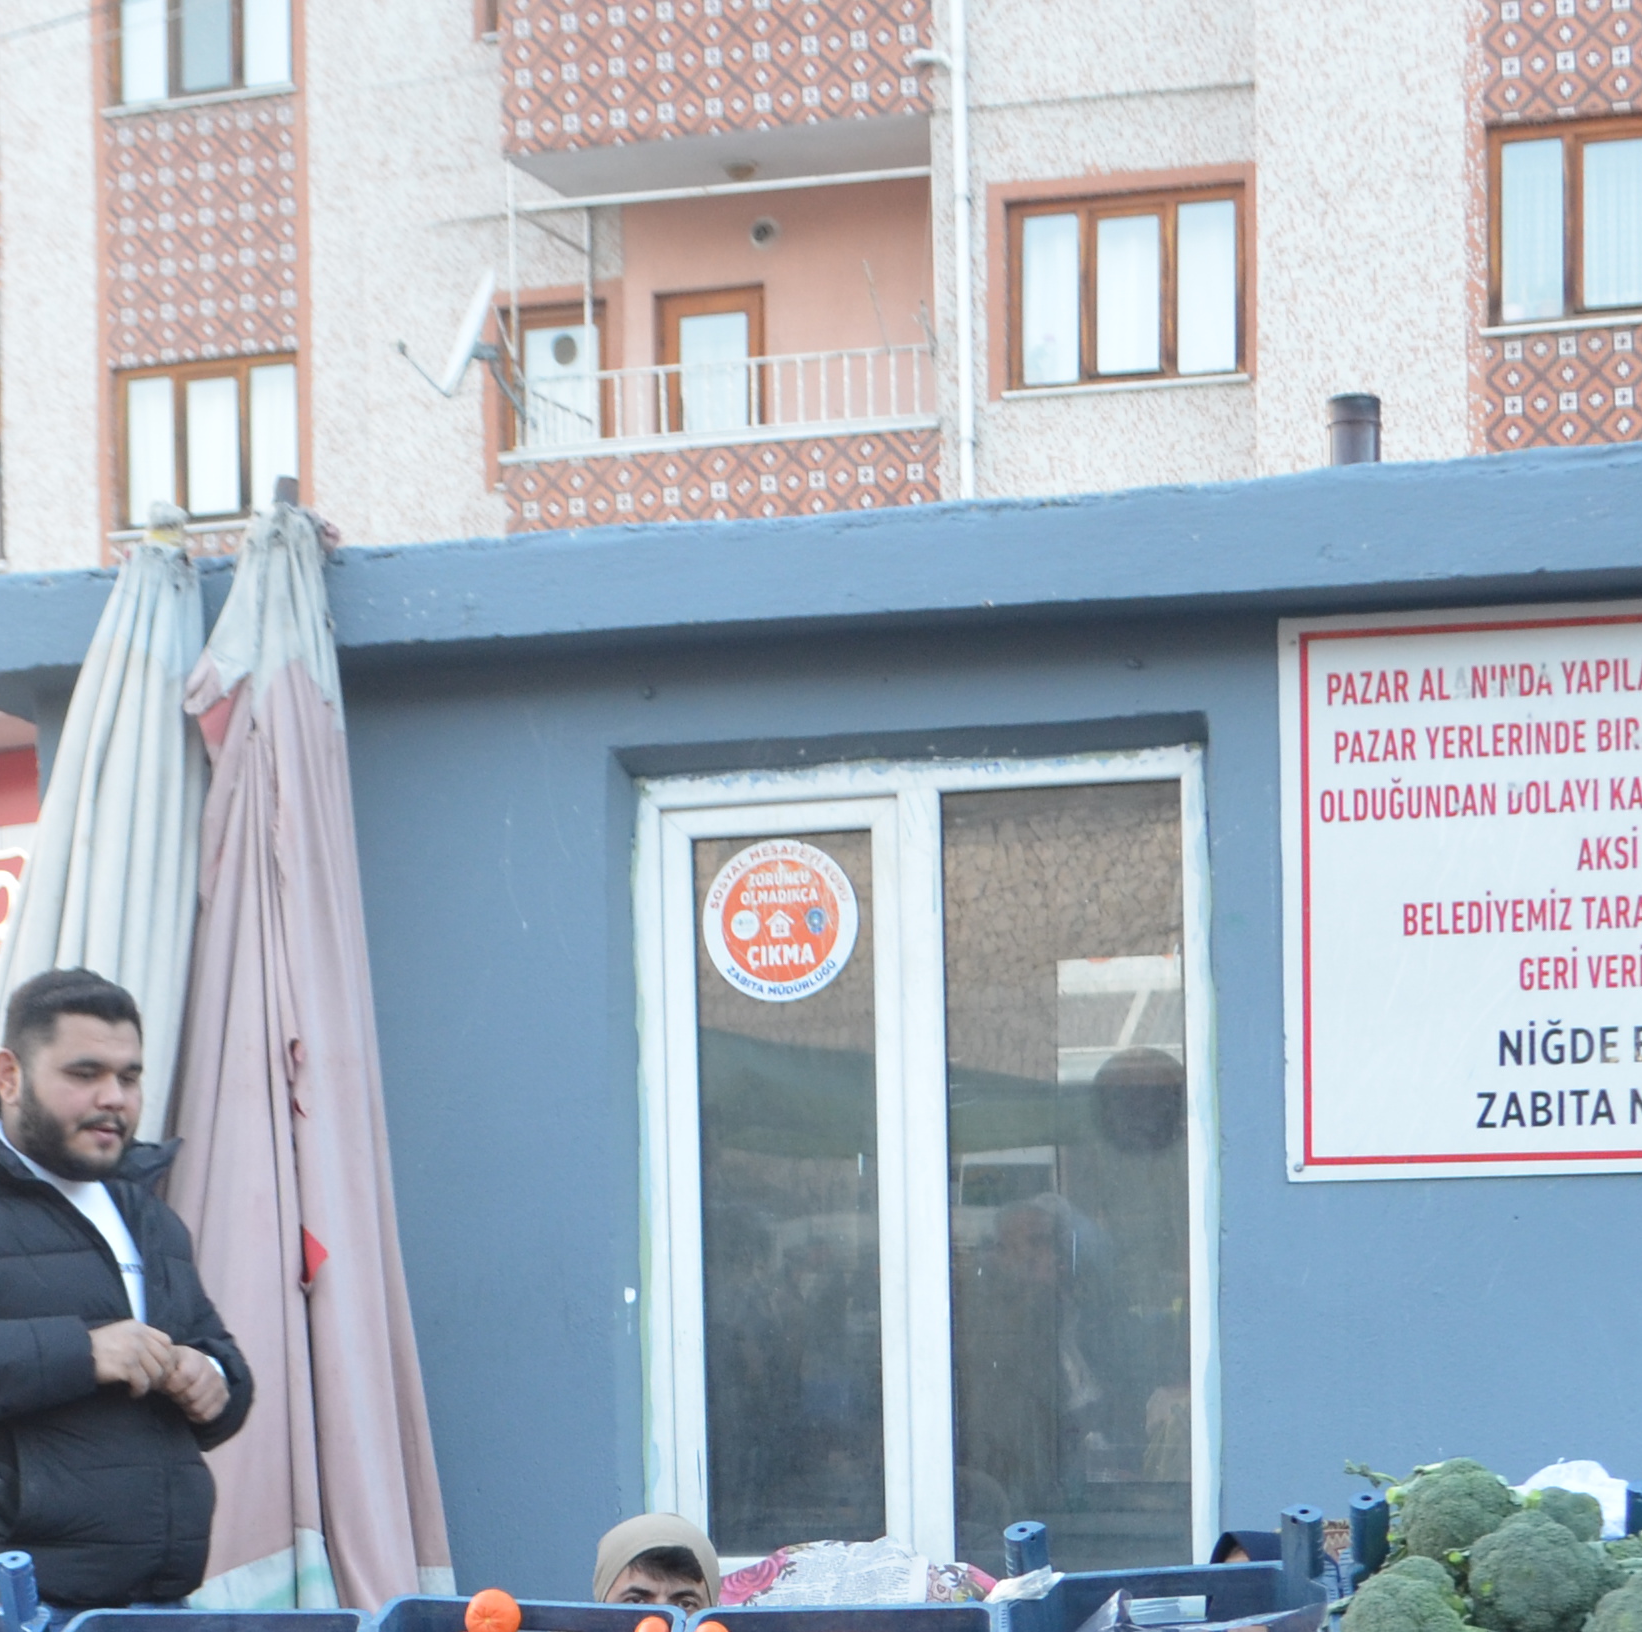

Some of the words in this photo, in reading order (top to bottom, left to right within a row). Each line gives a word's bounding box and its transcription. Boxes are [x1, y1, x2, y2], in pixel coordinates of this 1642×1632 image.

[1326, 669, 1410, 706] PAZAR
[1333, 727, 1417, 764] PAZAR
[1425, 715, 1587, 760] YERLERİNDE
[1319, 777, 1496, 823] OLDUĞUNDAN
[1507, 778, 1599, 816] DOLAYI
[1576, 825, 1638, 871] AKSİ
[710, 861, 749, 910] SOSYAL
[748, 844, 822, 867] MESAFEYİ
[740, 886, 819, 906] OLMADIKÇA
[1403, 888, 1572, 936] BELEDİYEMİZ
[726, 964, 765, 994] ZABITA
[767, 958, 837, 996] MÜDÜRLÜĞÜ
[747, 942, 816, 970] ÇIKMA
[1519, 945, 1578, 991] GERİ
[1498, 1018, 1620, 1067] NİĞDE
[1476, 1087, 1617, 1129] ZABITA
